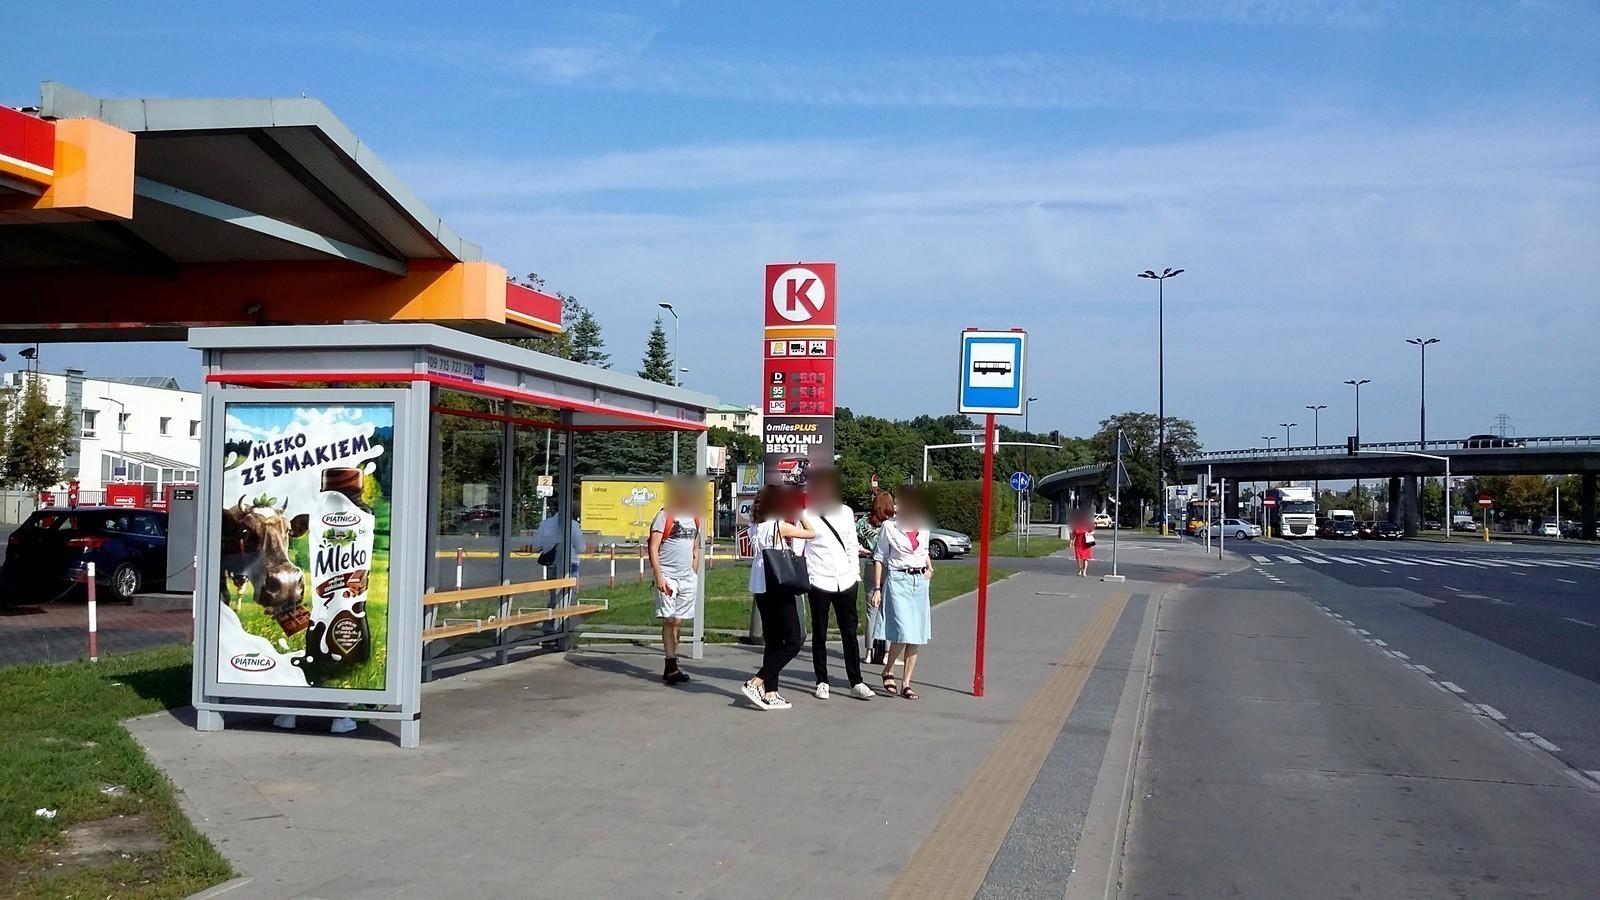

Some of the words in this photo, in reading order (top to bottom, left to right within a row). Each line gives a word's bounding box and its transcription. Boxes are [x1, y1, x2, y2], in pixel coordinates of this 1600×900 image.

[786, 278, 820, 317] K
[774, 372, 783, 380] D
[772, 386, 783, 395] 95
[770, 401, 785, 409] LPG
[766, 434, 823, 445] UWOLNIJ
[252, 432, 307, 462] MLEKO
[766, 444, 808, 456] BESTIĘ
[240, 464, 266, 487] ZE
[271, 433, 369, 478] SMAKIEM
[325, 515, 357, 523] PIĄTNICA
[314, 543, 367, 578] Mleko
[235, 657, 271, 667] PIĄTNICA
